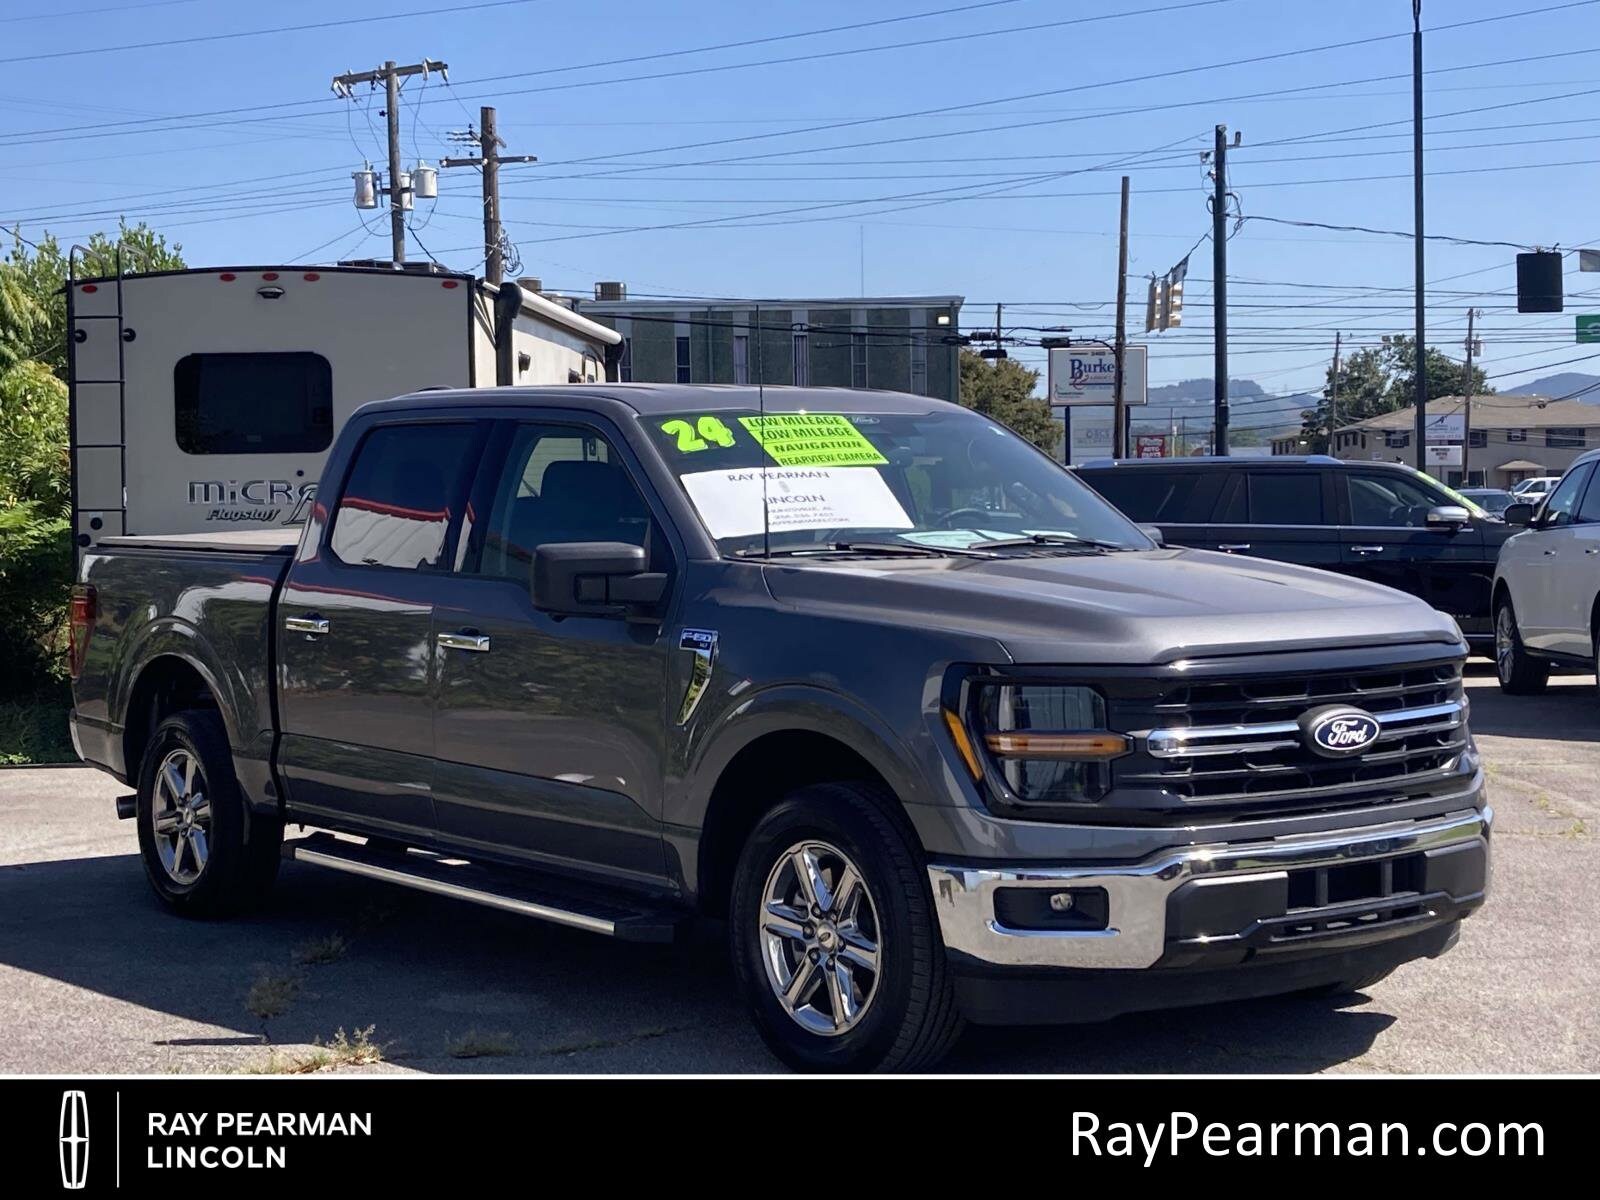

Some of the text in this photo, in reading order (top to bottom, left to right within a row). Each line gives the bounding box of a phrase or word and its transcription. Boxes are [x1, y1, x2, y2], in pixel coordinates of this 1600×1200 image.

[747, 416, 843, 427] LOW MILEAGE
[661, 416, 736, 453] 24
[760, 427, 854, 440] LOW MILEAGE
[774, 441, 863, 453] NAVIGATION
[780, 453, 882, 466] REARVIEW CAMERA
[727, 471, 830, 482] RAY PEARMAN
[206, 508, 281, 521] Flagstaff
[1327, 720, 1368, 745] Ford
